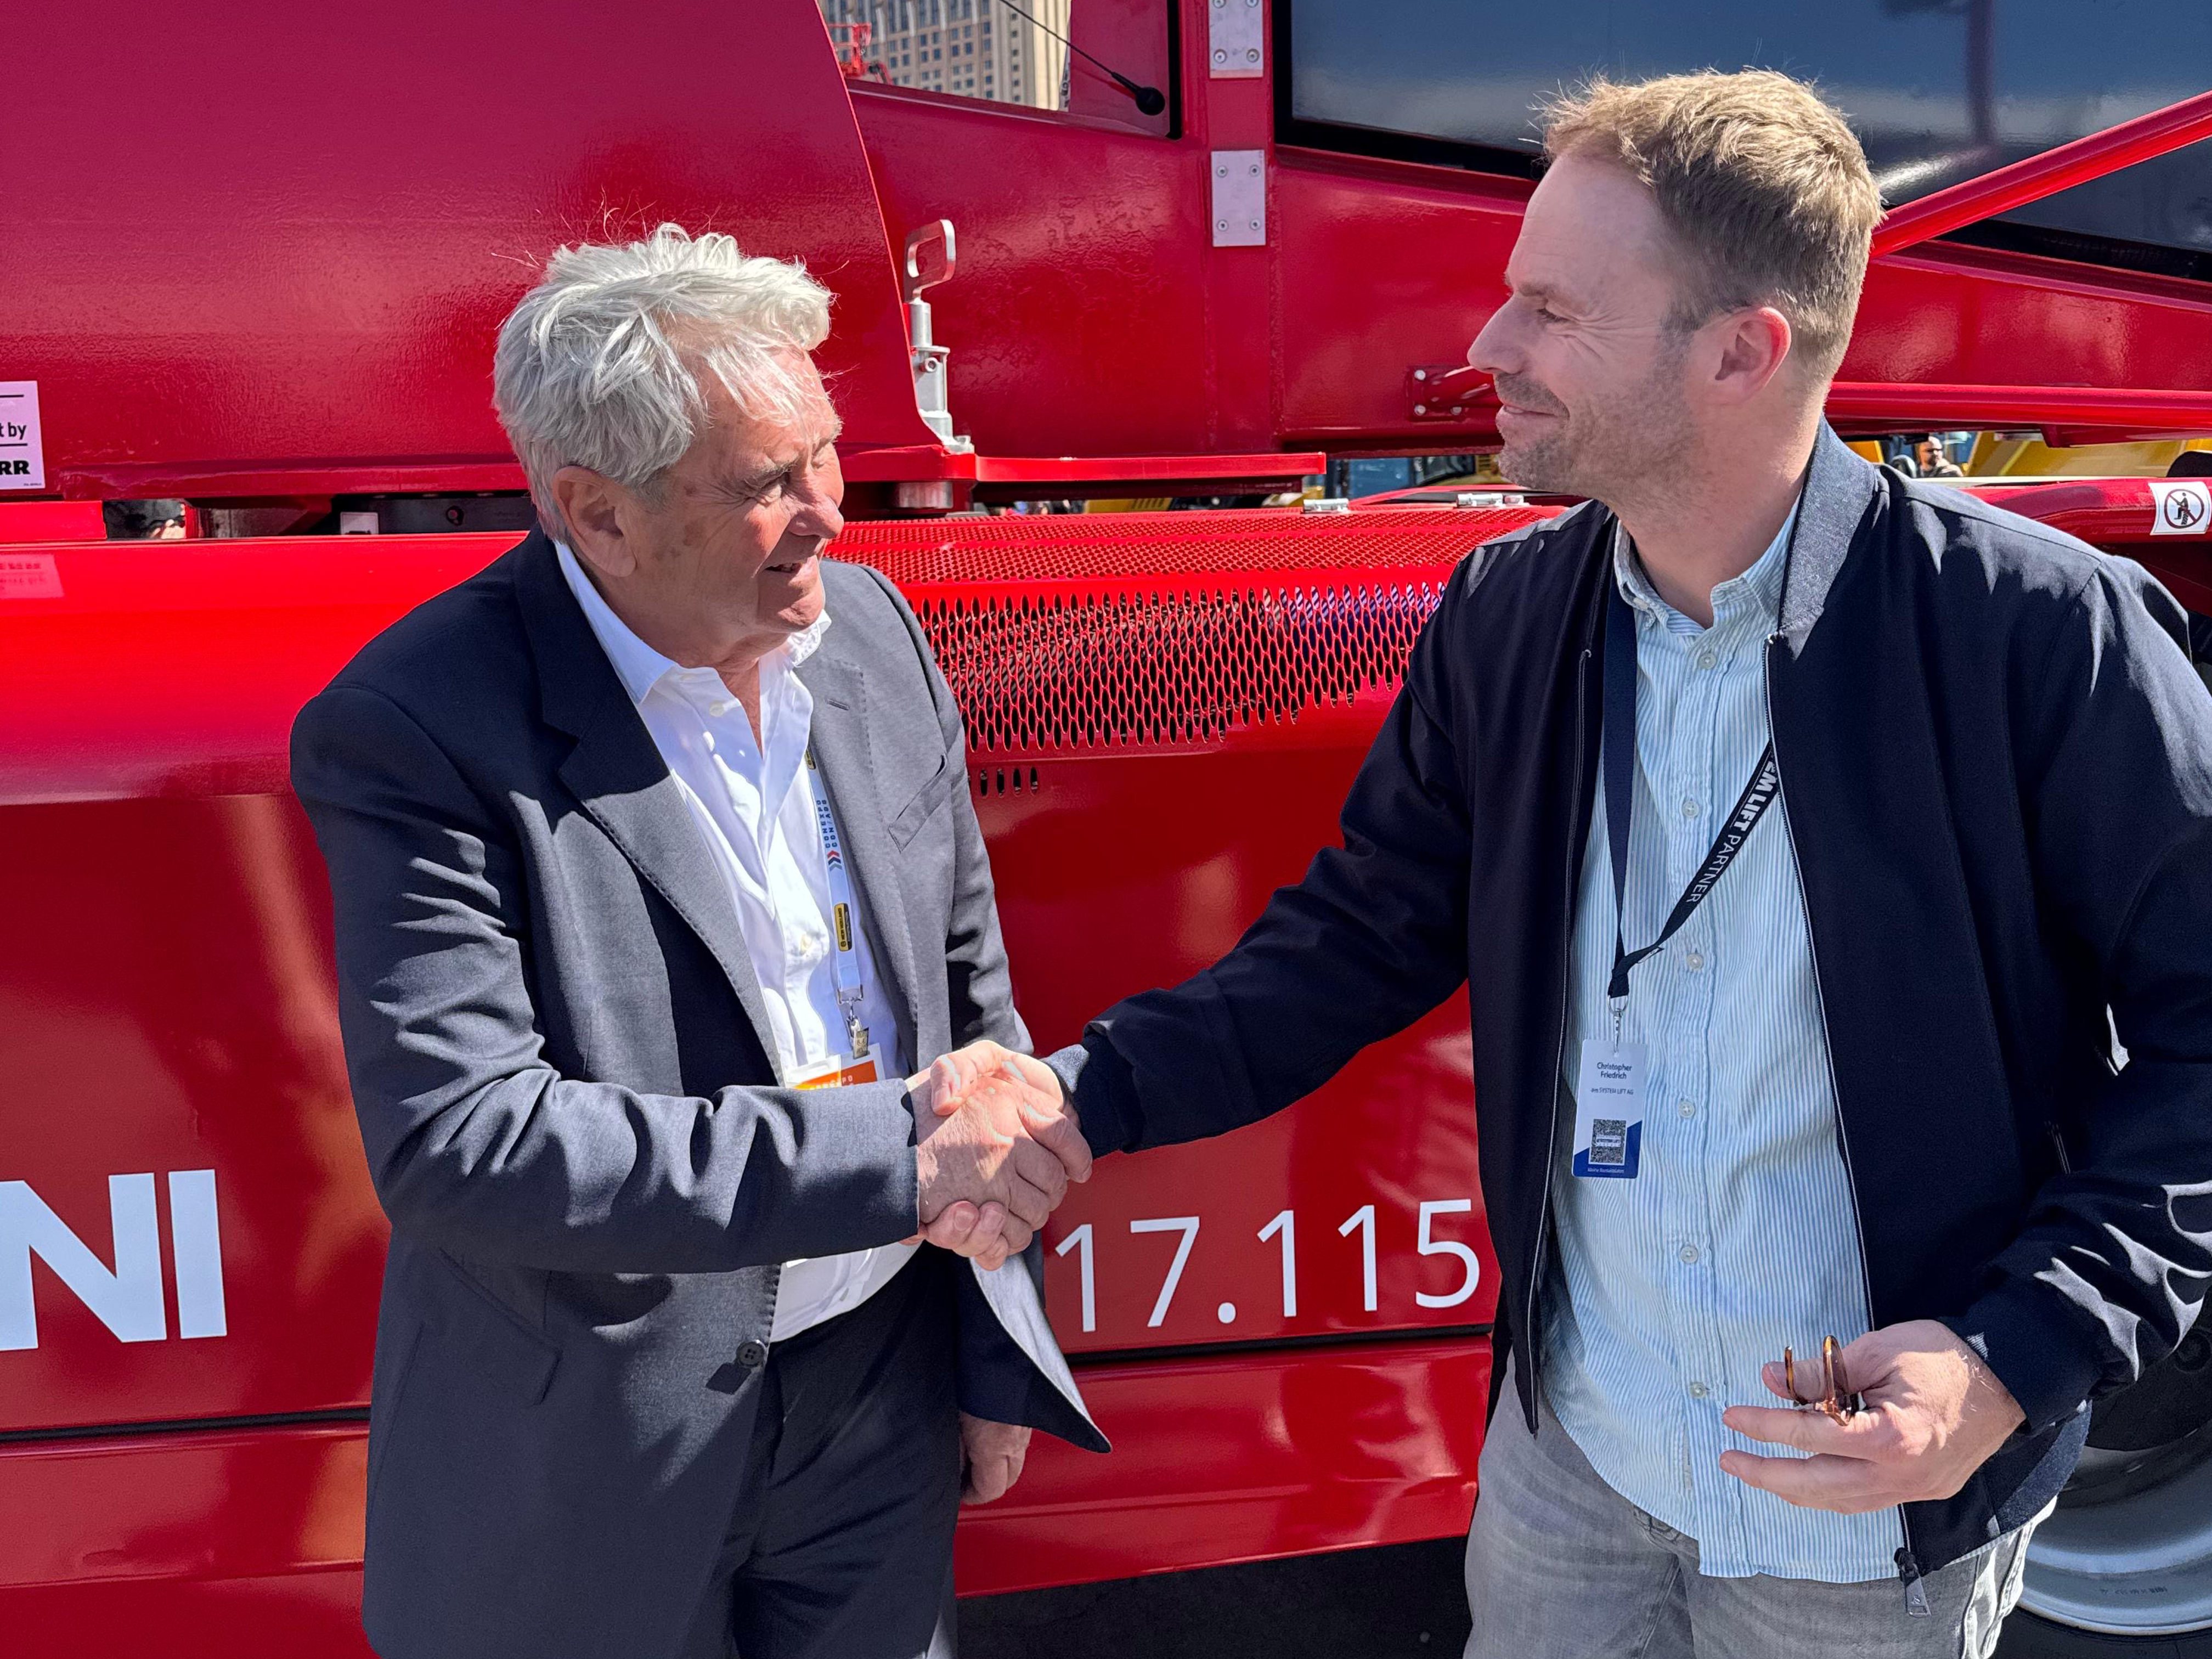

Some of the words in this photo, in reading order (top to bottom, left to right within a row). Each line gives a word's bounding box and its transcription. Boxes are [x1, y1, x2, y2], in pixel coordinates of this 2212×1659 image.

[8, 422, 27, 440] by
[0, 460, 31, 475] RR
[816, 800, 831, 848] CONEXPO
[1734, 795, 1767, 832] LIFT
[1686, 834, 1741, 902] PARTNER
[1597, 1062, 1632, 1072] Christopher
[1601, 1071, 1627, 1079] Friedrich
[0, 1169, 227, 1351] NI
[1056, 1199, 1480, 1333] 17.115
